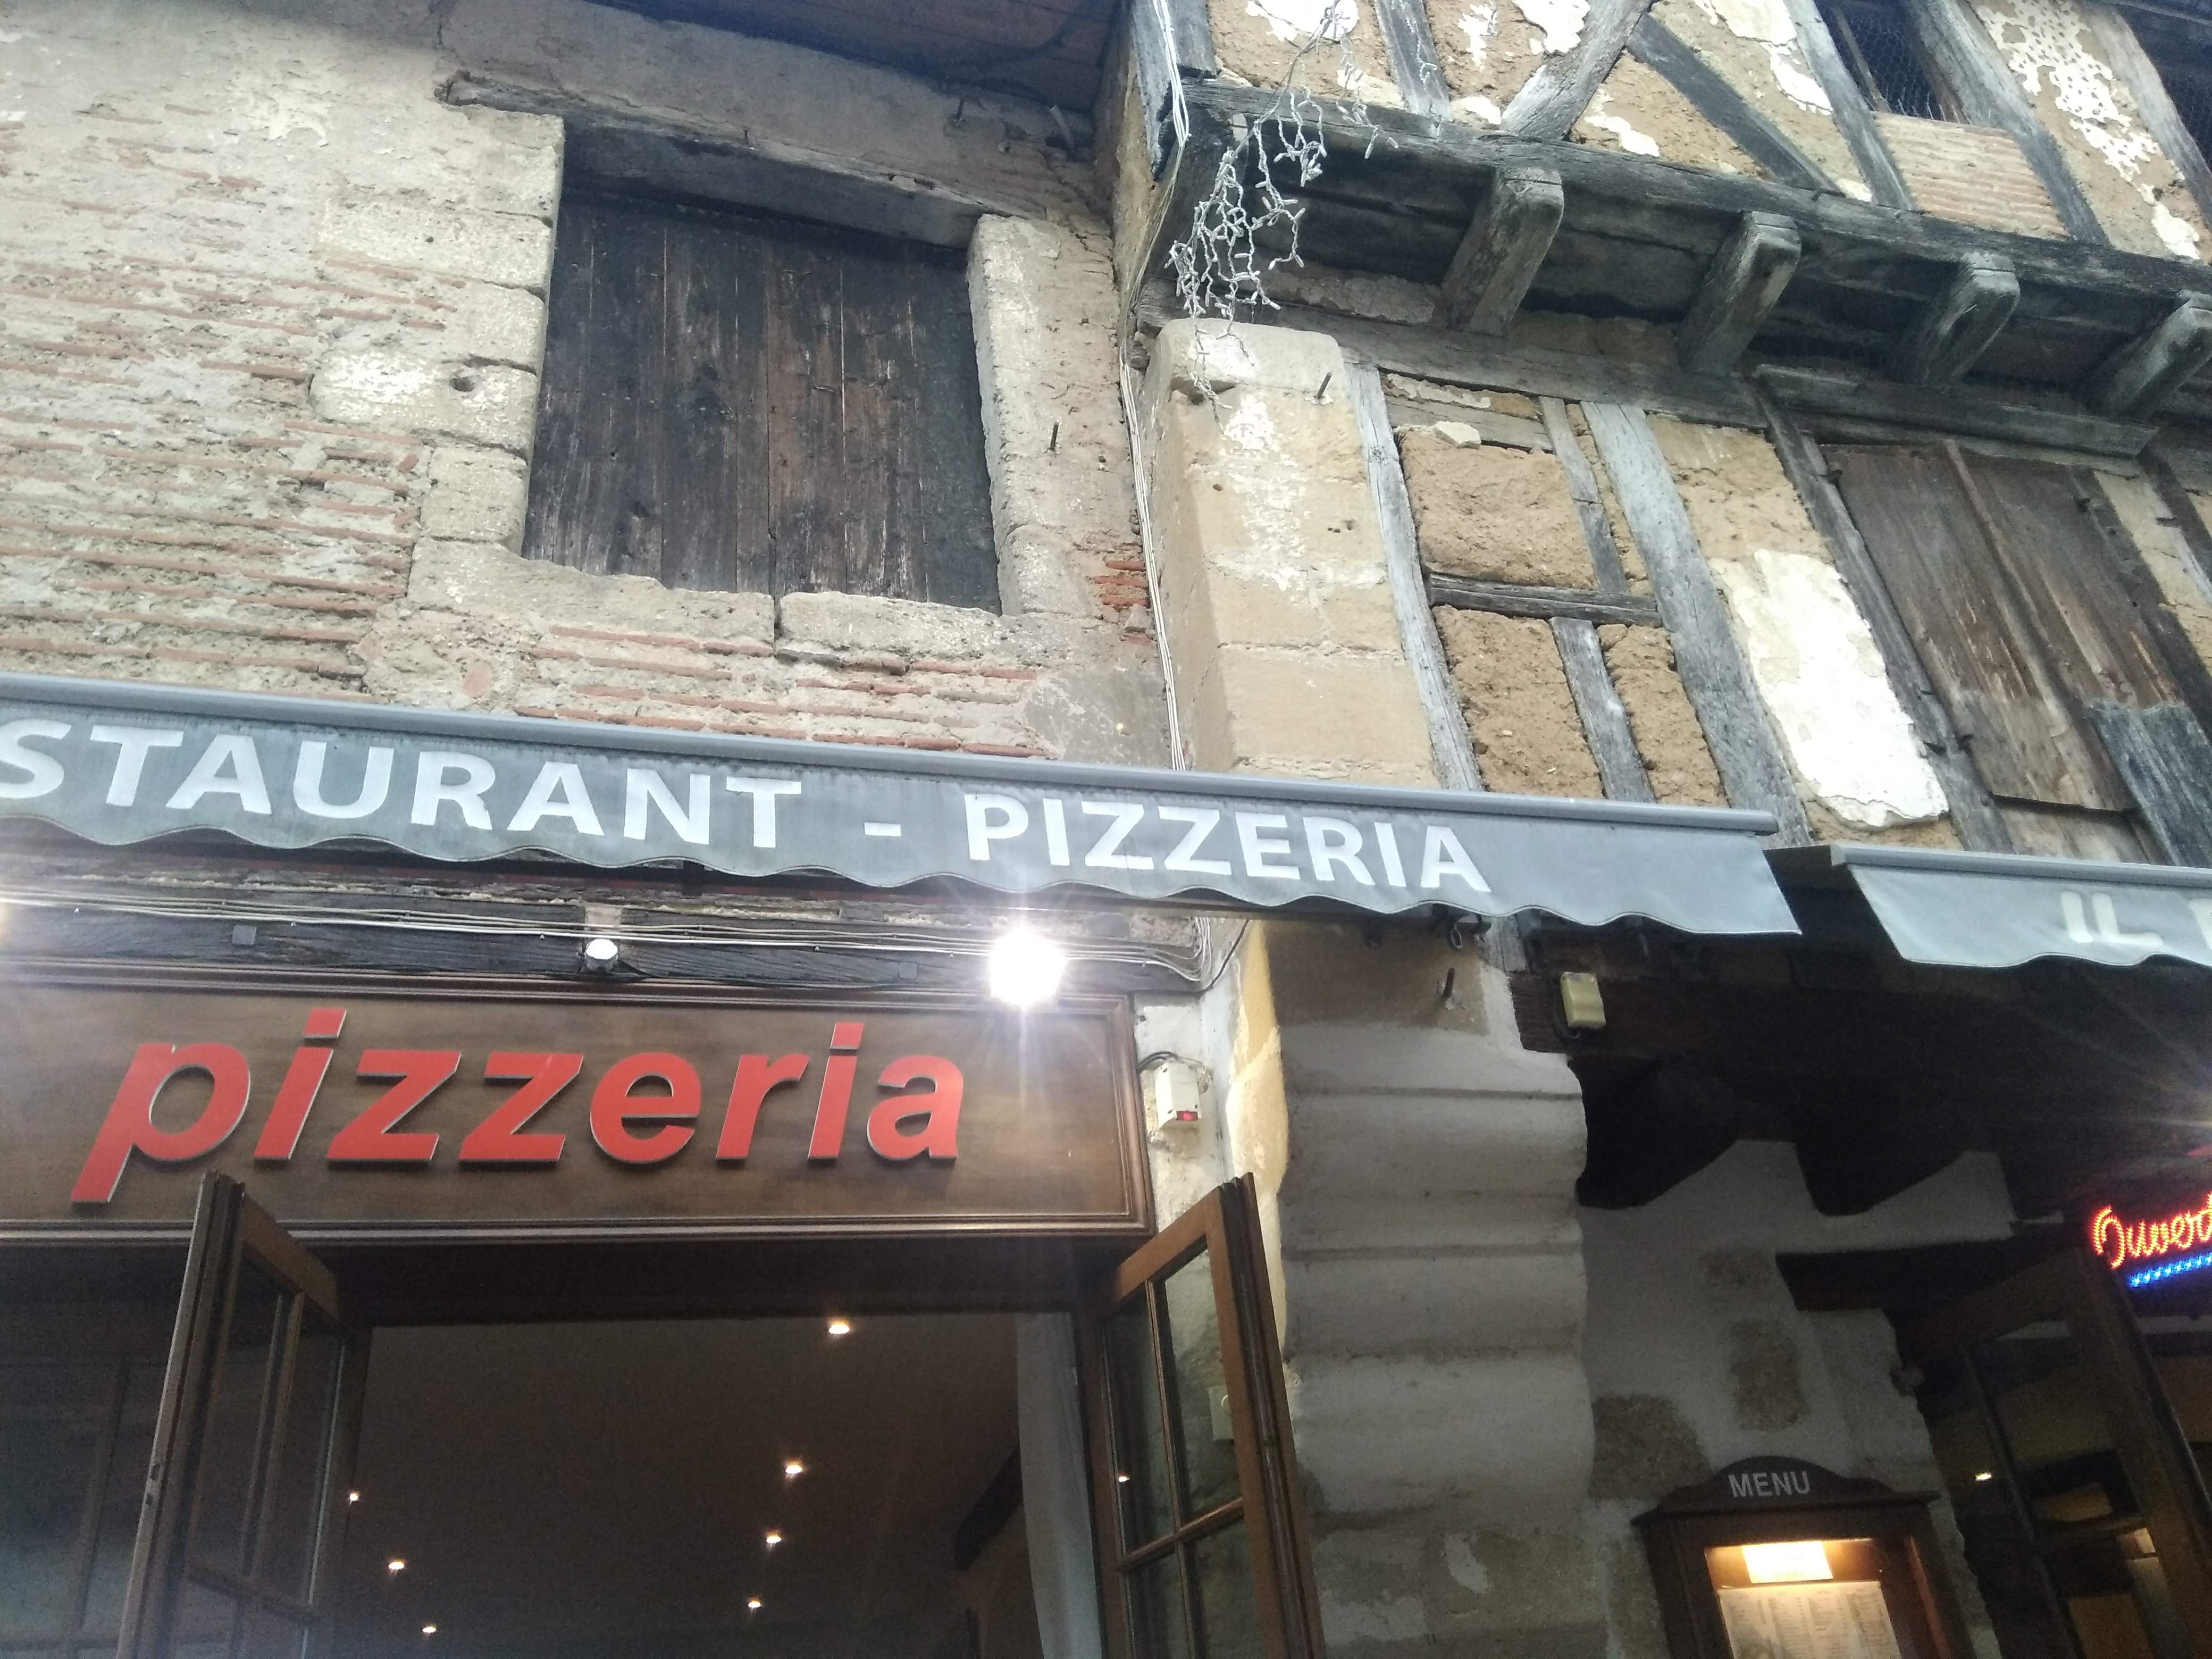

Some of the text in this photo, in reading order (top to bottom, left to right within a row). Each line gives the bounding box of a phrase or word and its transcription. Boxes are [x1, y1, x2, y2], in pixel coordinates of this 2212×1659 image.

[0, 718, 1492, 892] STAURANT - PIZZERIA
[2061, 890, 2163, 946] IL
[70, 1008, 963, 1204] pizzeria
[1729, 1471, 1810, 1497] MENU
